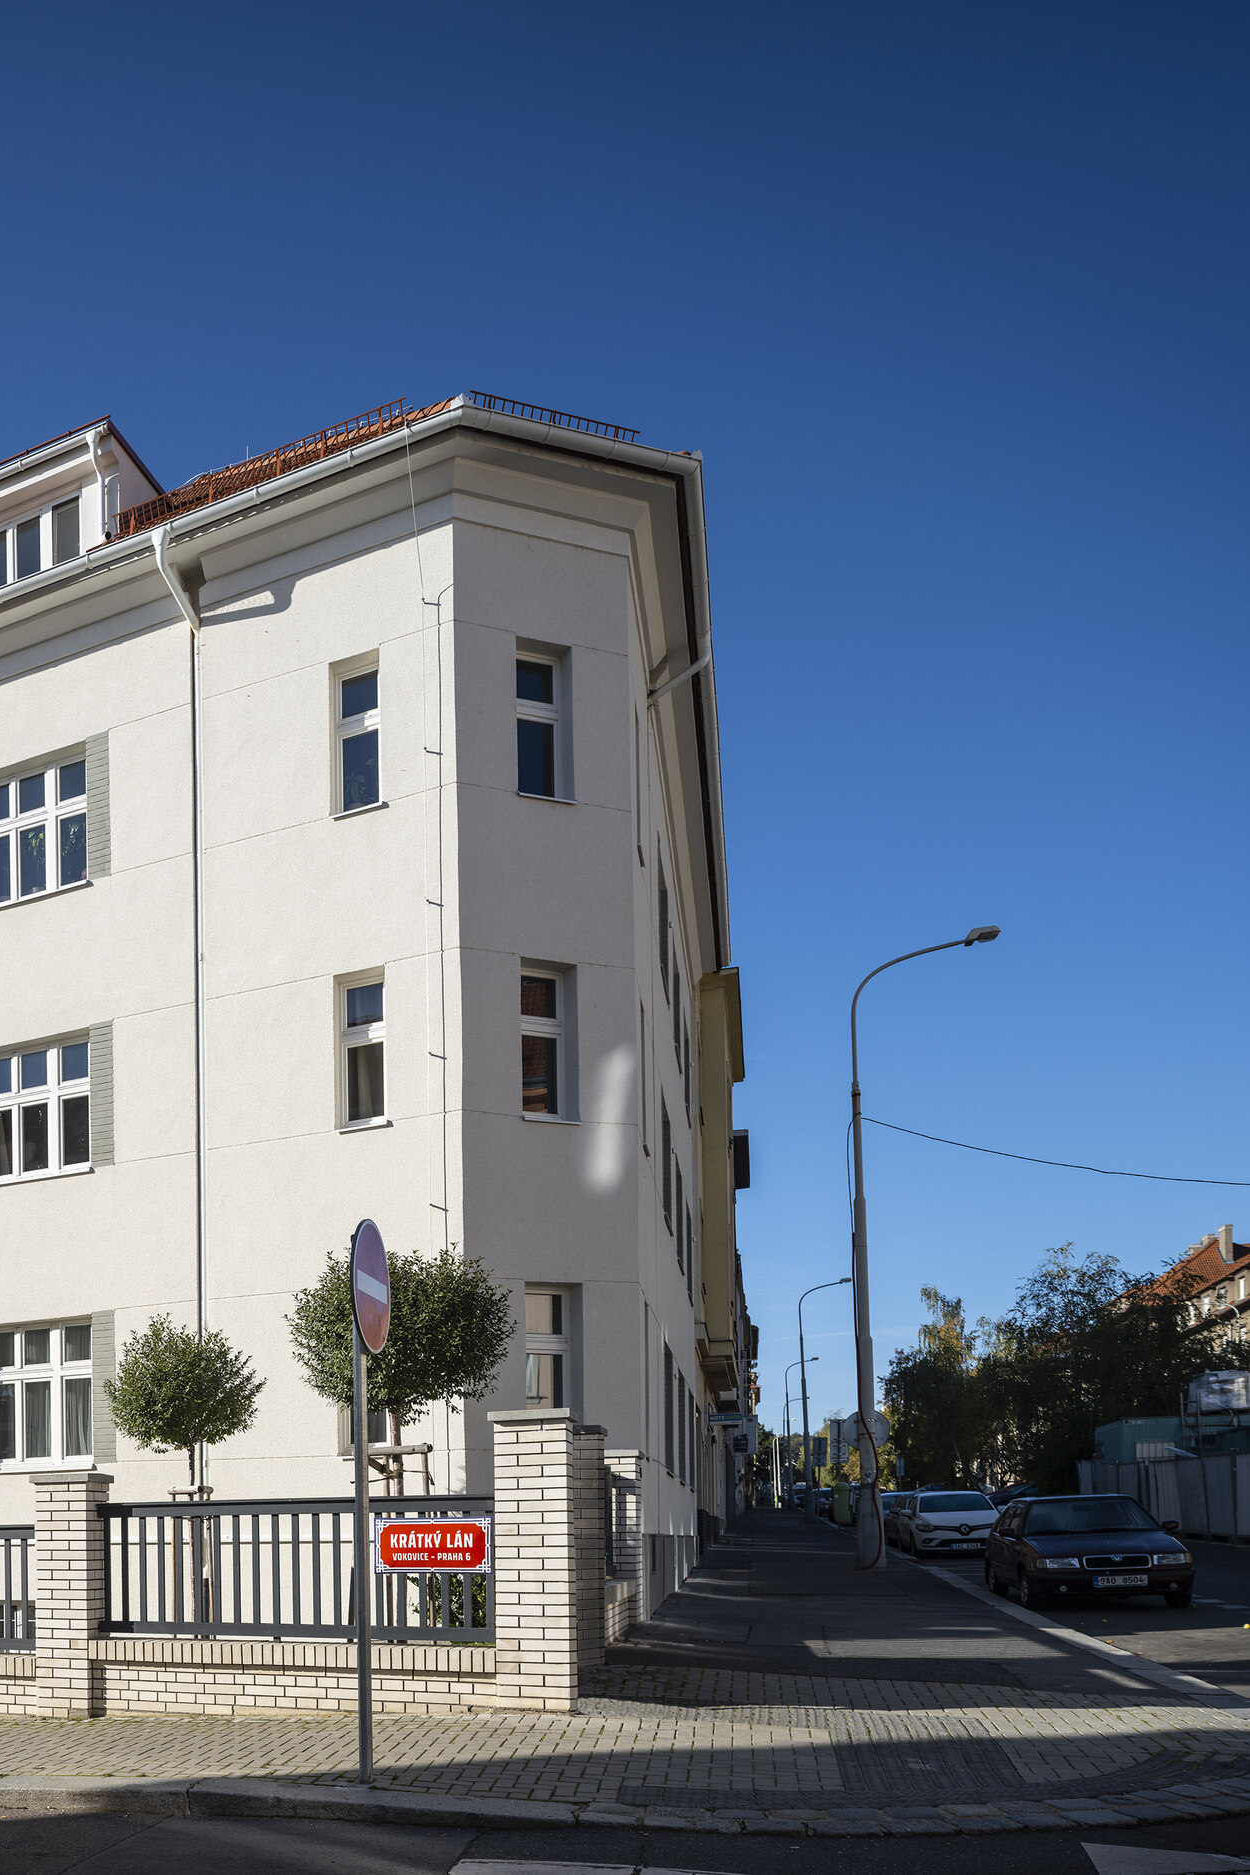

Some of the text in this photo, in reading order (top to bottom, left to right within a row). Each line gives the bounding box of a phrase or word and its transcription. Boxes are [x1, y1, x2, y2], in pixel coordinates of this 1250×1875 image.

[390, 1530, 474, 1548] KRÁTKÝ LÁN
[392, 1552, 429, 1561] VOKOVICE
[437, 1552, 463, 1561] PRAHA
[465, 1552, 471, 1561] 6
[1122, 1576, 1145, 1584] 8504
